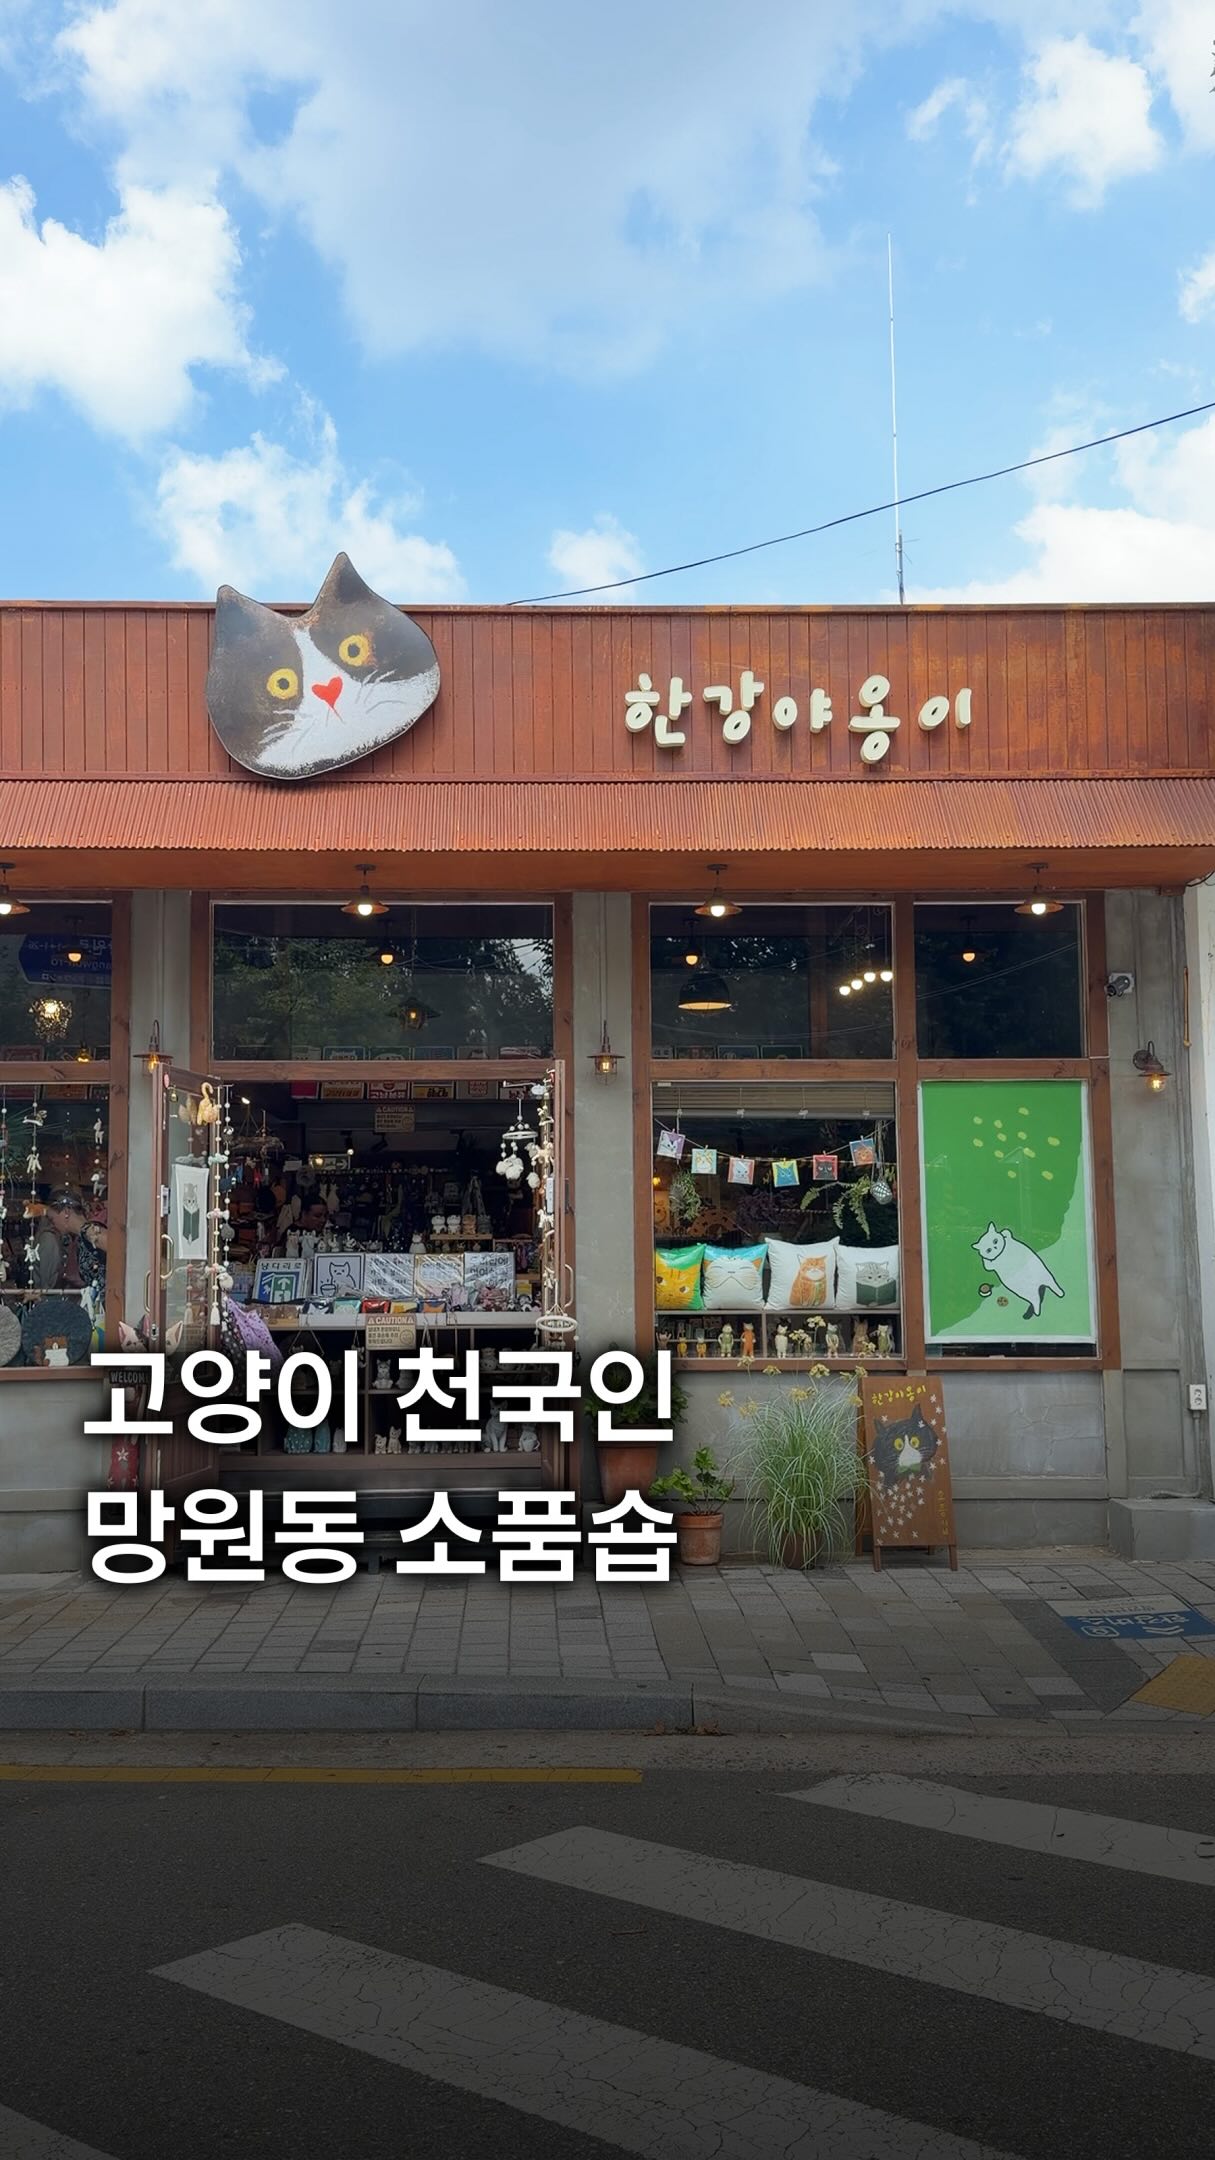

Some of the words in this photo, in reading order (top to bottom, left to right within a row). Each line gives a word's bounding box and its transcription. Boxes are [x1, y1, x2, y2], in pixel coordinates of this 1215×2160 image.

[625, 670, 972, 764] 한강야옹이
[375, 1316, 408, 1324] CAUTION
[111, 1371, 147, 1383] WELCOM
